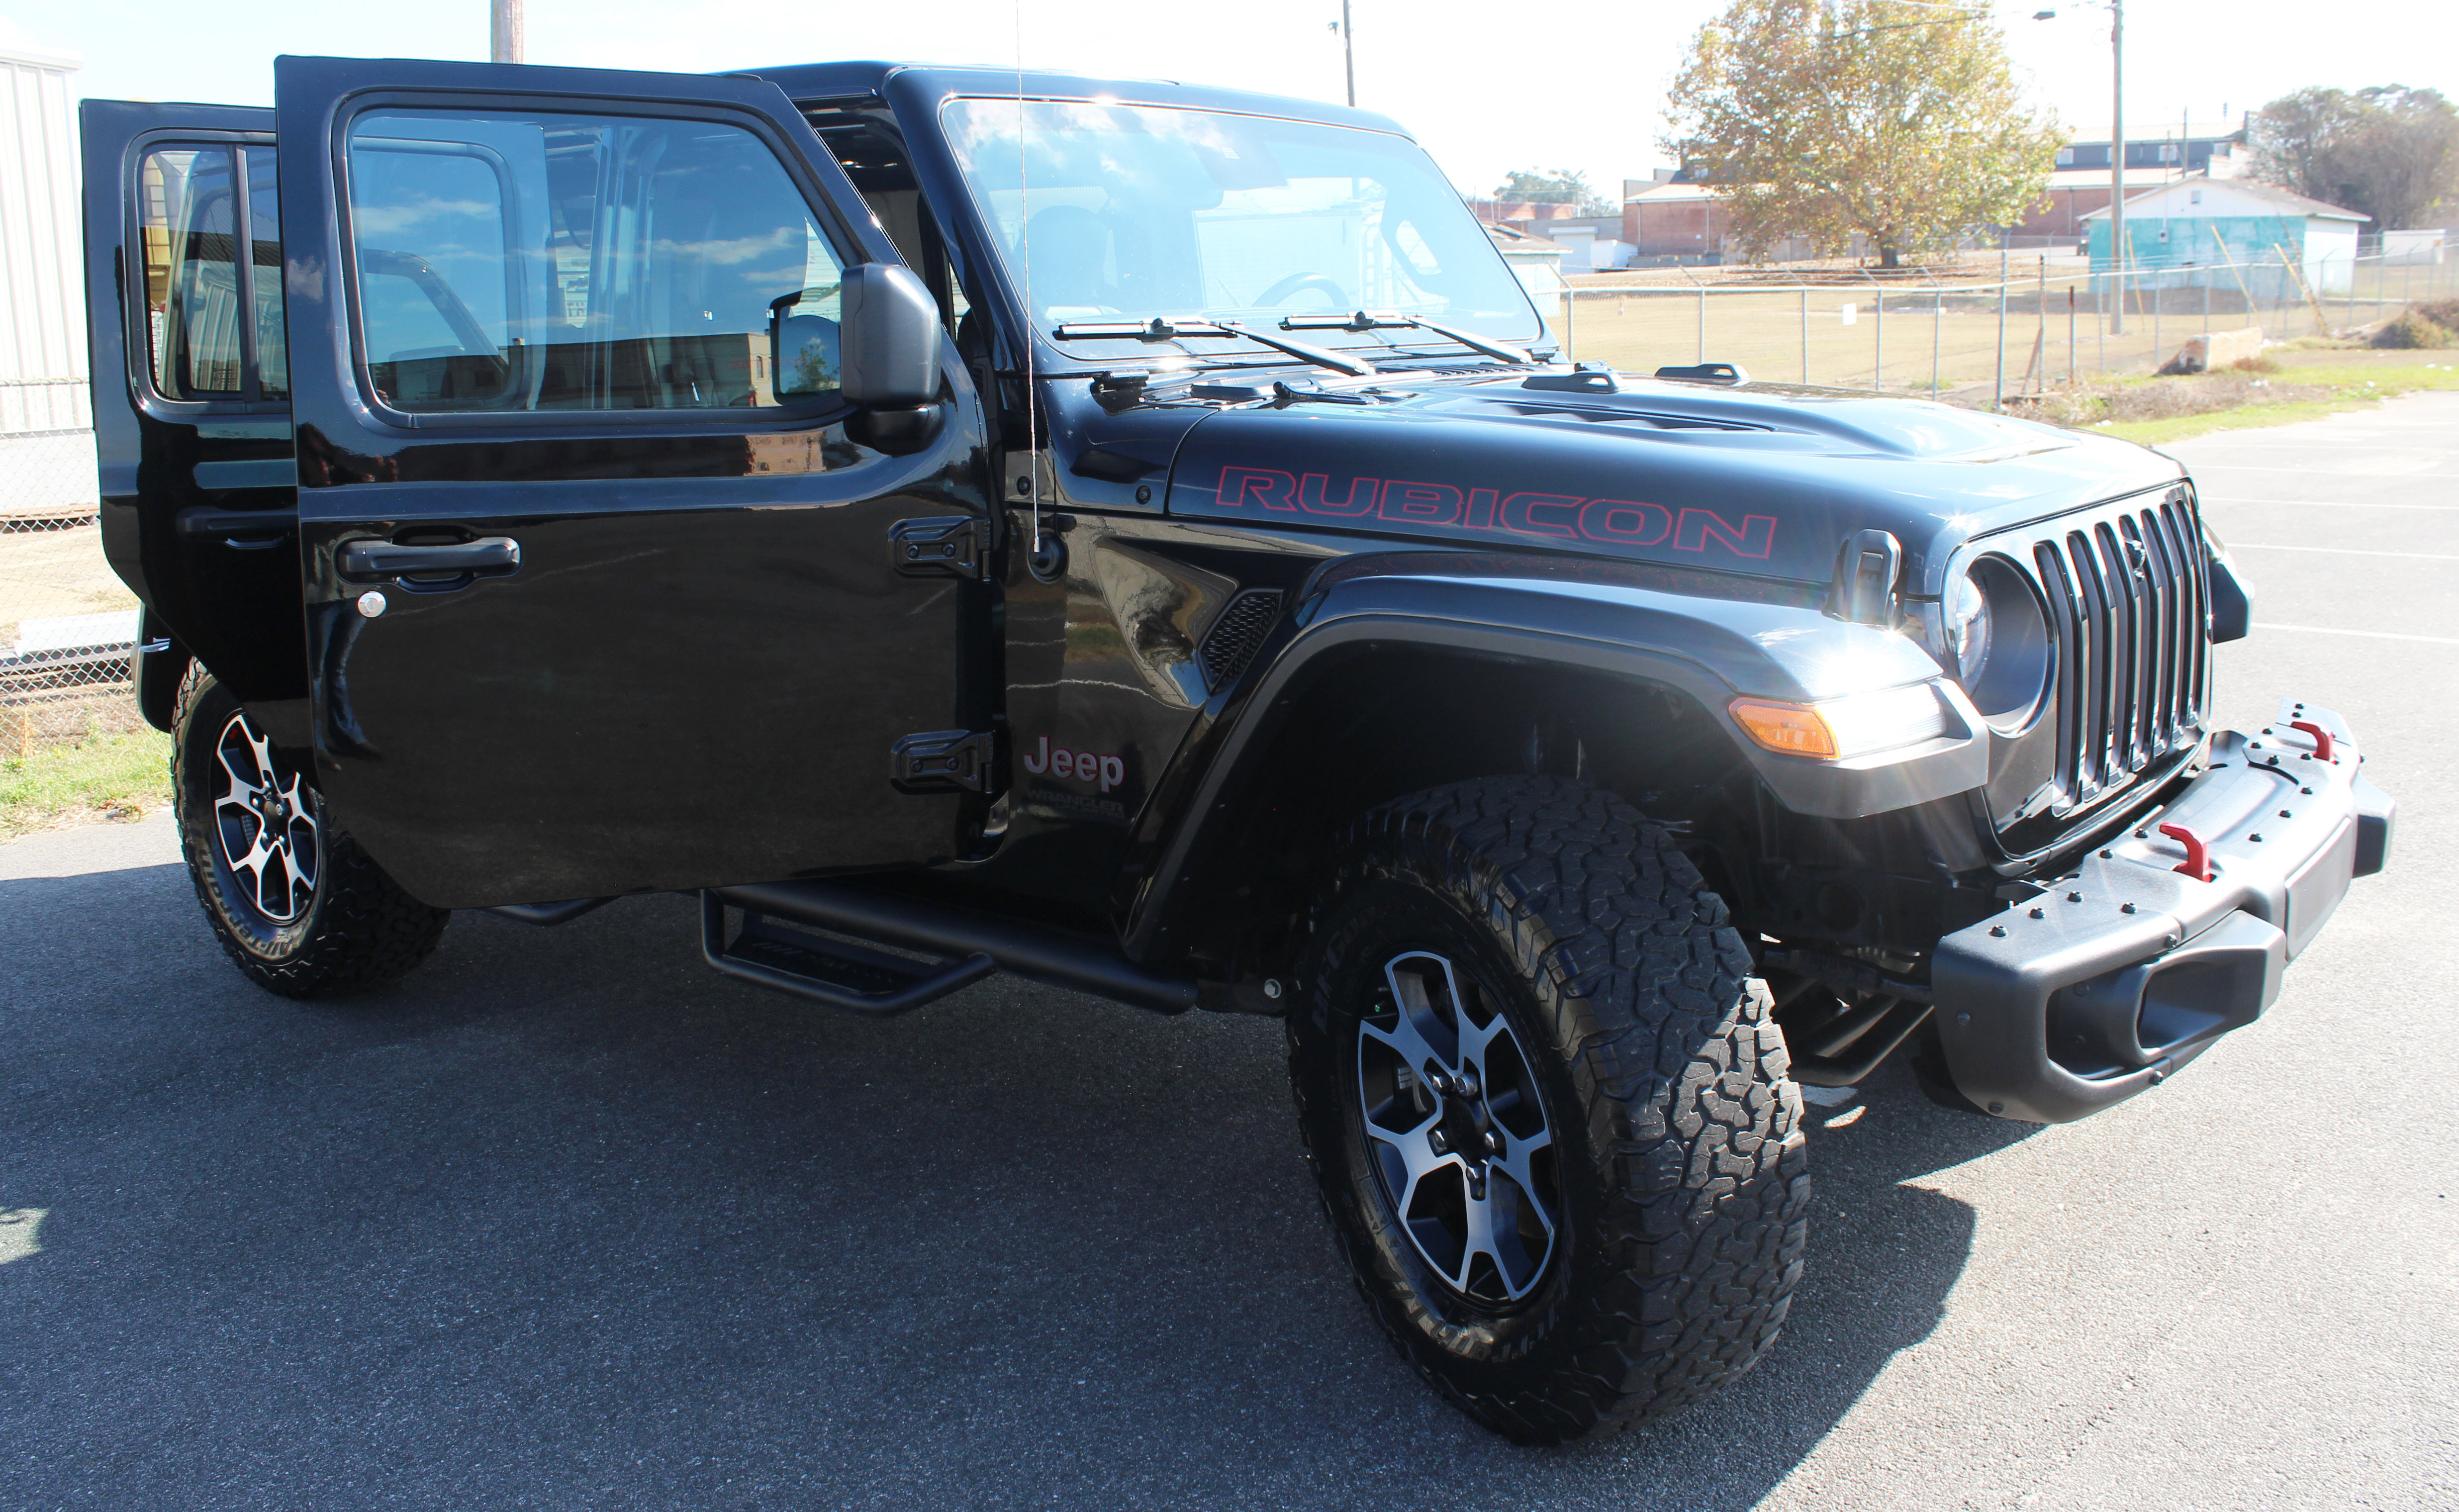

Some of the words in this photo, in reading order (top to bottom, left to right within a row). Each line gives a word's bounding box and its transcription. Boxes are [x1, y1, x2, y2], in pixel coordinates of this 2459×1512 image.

[1215, 466, 1777, 559] RUBICON
[1024, 735, 1125, 793] Jeep
[1026, 787, 1124, 812] WRANGLER
